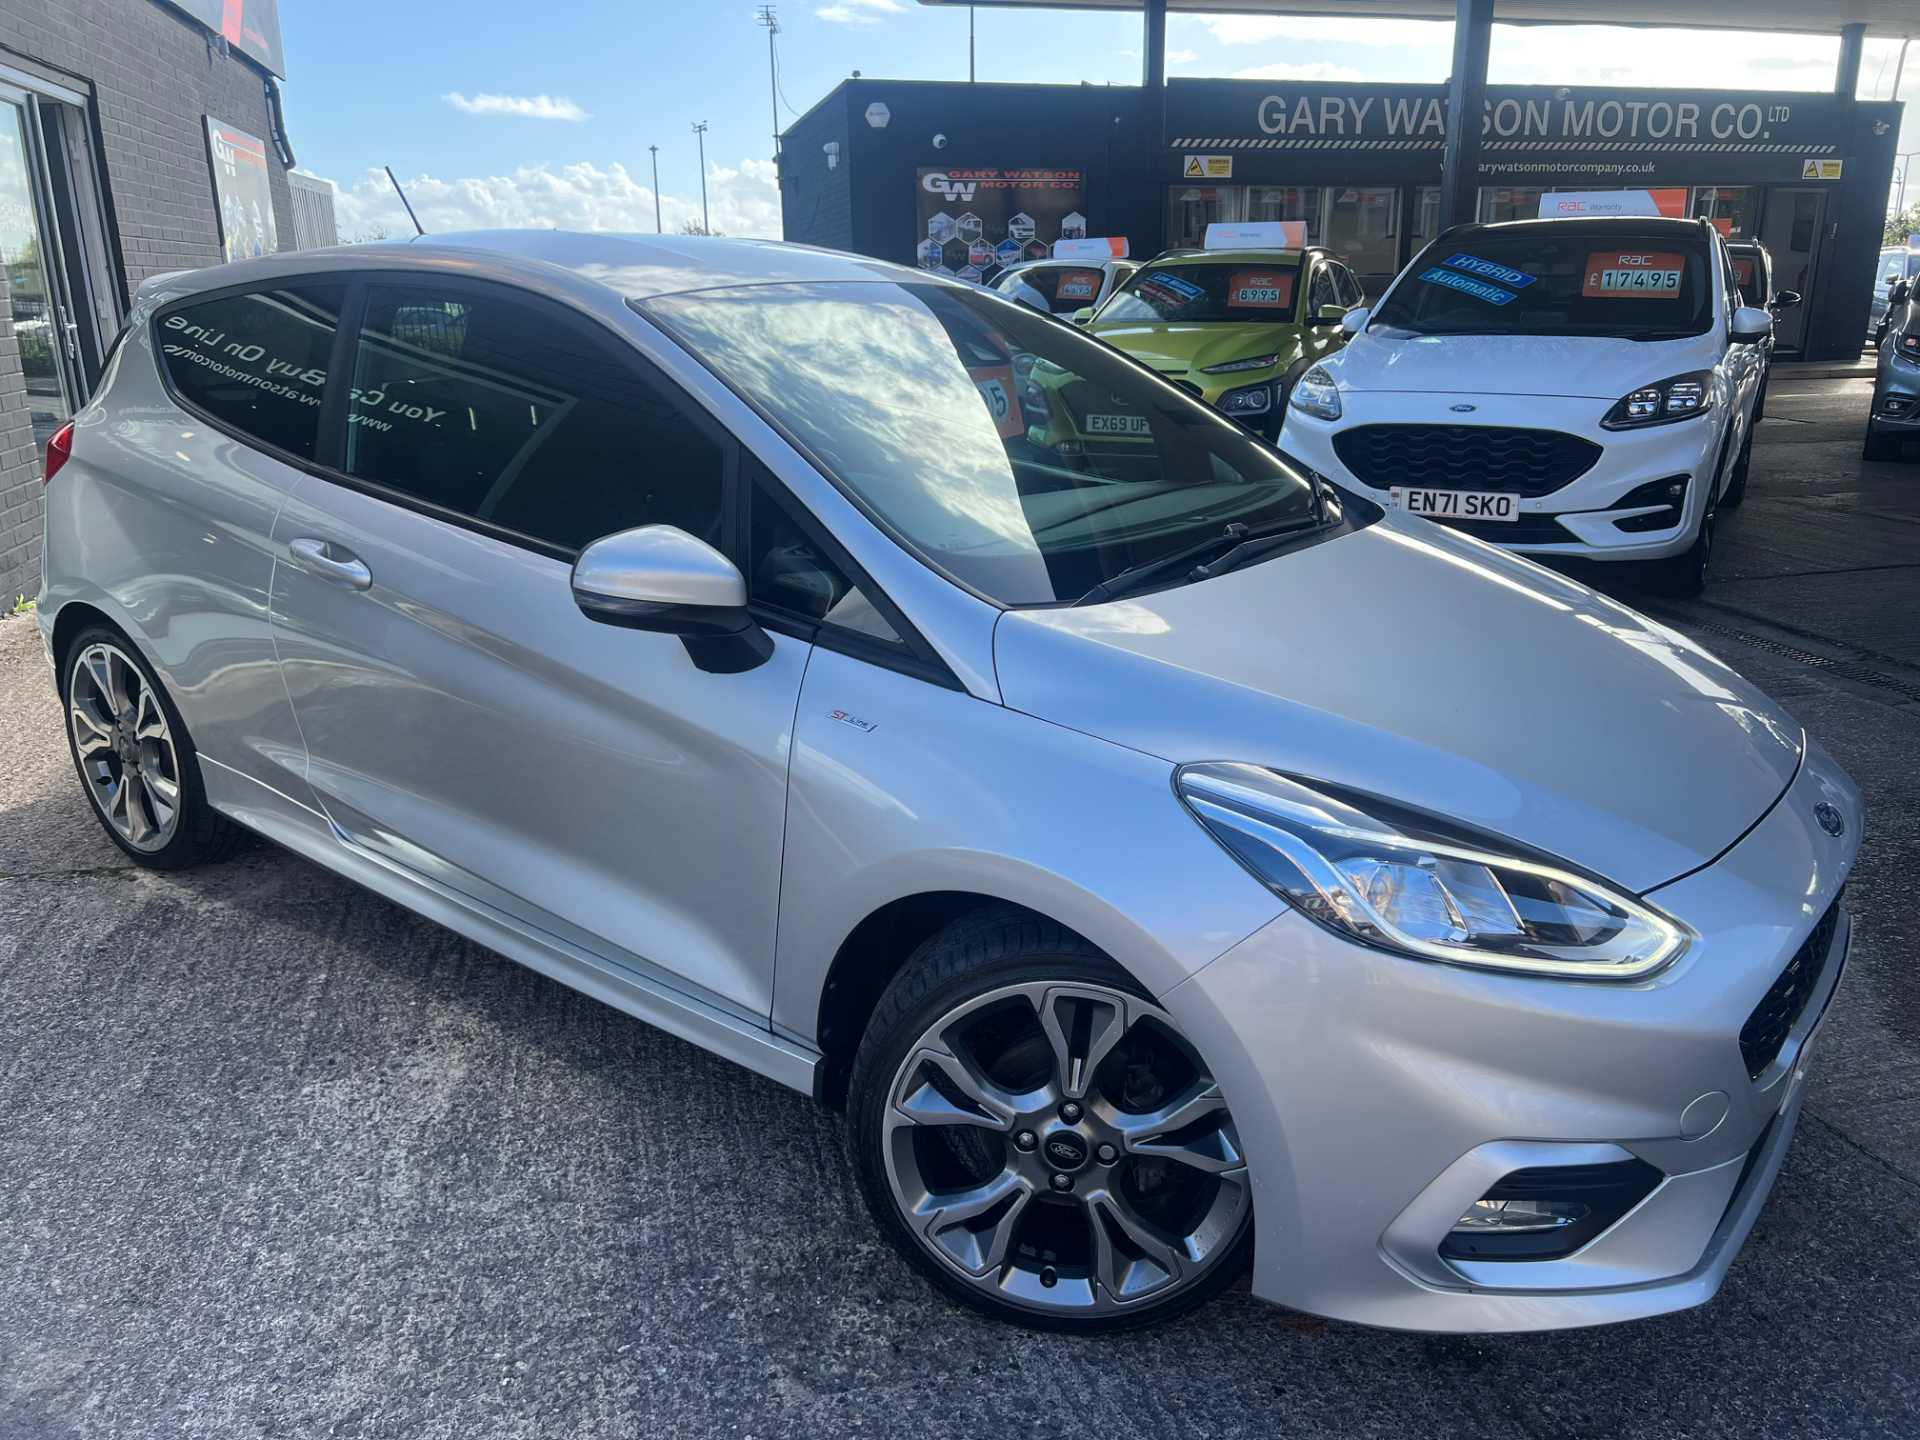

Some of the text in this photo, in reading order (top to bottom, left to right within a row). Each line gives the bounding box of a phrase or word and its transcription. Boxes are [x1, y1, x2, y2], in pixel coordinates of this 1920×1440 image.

[1257, 95, 1790, 139] GARY WAON MOTOR CO. LTD
[1003, 171, 1080, 179] WATSON
[1440, 161, 1656, 175] arywatsonmotorcompany.co.uk
[922, 172, 977, 201] GW
[980, 181, 1079, 189] MOTOR CO.
[1589, 203, 1623, 212] Warranty
[1453, 257, 1523, 282] HYBRID
[1426, 270, 1505, 301] Automatic
[1453, 404, 1475, 412] Ford
[1092, 416, 1148, 432] EX69 UF
[1408, 490, 1512, 517] EN71 SKO
[1053, 1143, 1079, 1159] Ford
